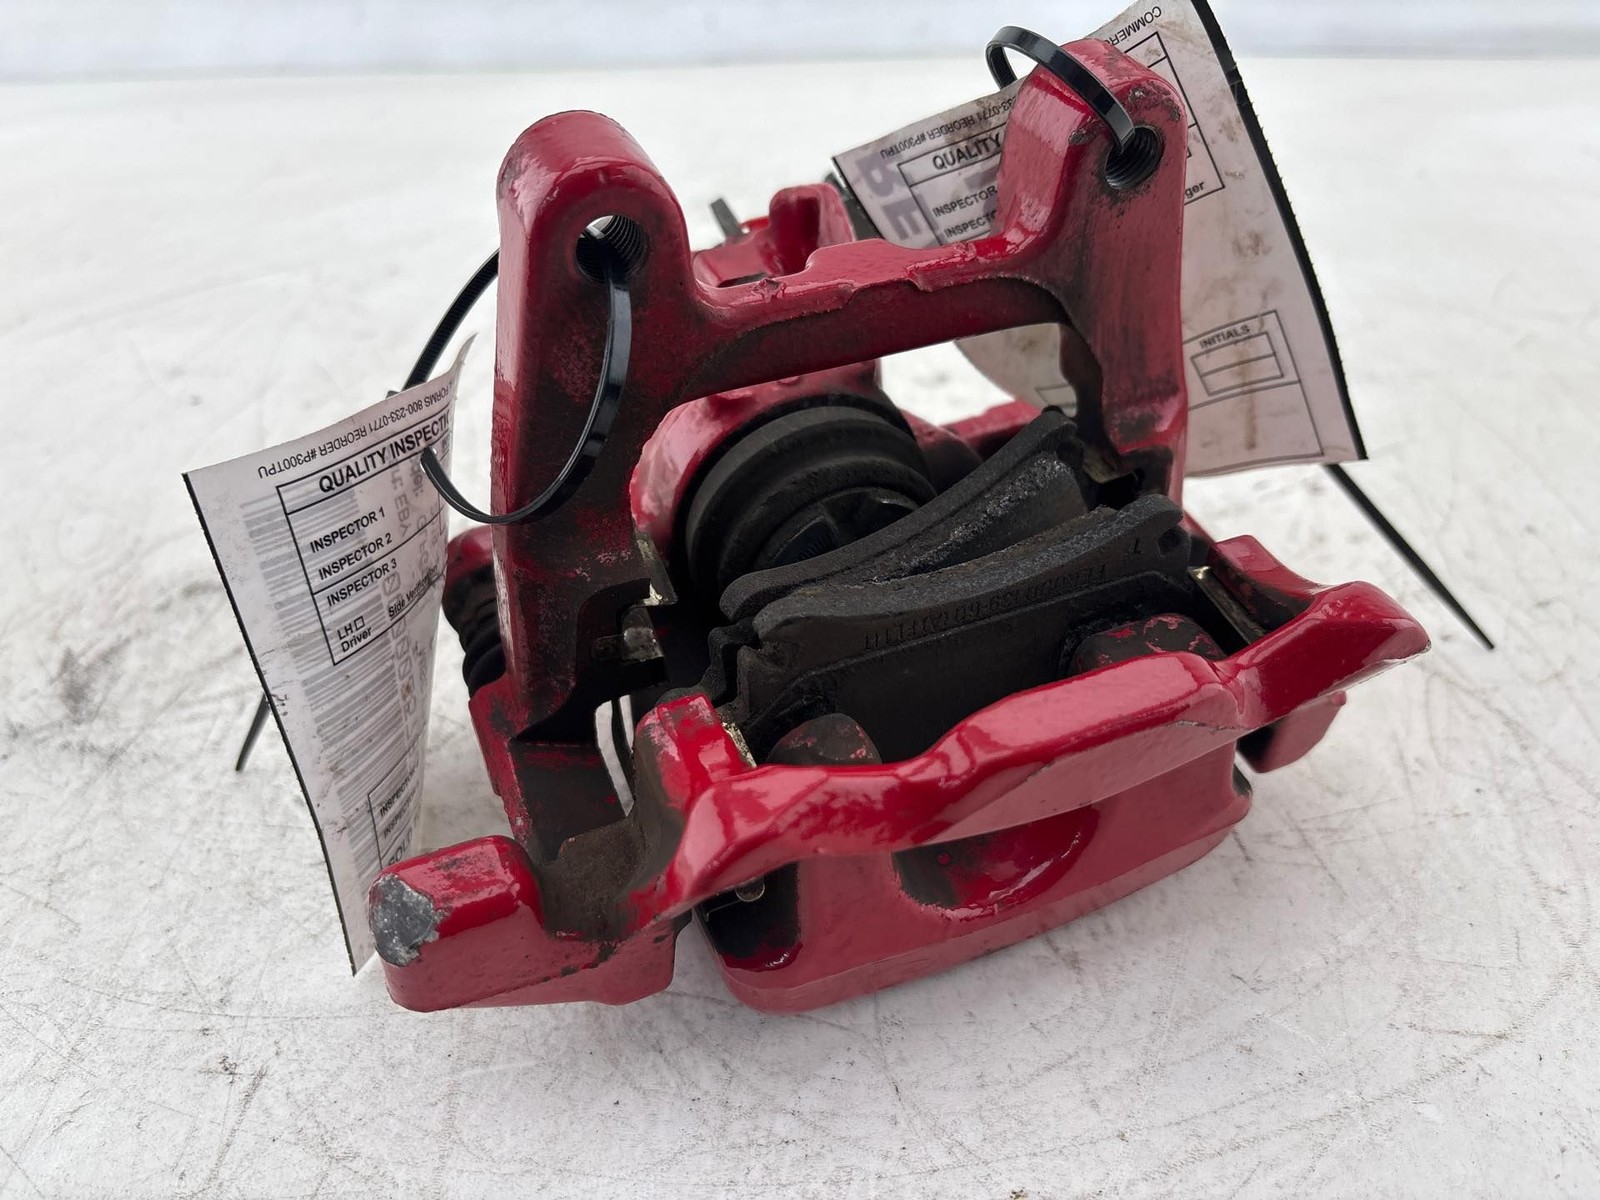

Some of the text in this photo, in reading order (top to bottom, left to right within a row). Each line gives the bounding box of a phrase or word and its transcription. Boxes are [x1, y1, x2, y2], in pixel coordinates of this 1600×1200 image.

[1106, 6, 1162, 46] COMMER
[880, 134, 927, 160] #P300TPU
[927, 115, 975, 141] REORDER
[932, 132, 1001, 170] QUALITY
[932, 185, 997, 217] INSPECTOR
[1200, 324, 1251, 349] INITIALS
[258, 386, 449, 479] FORMS 800-233-0771 REORDER #P300TPU
[319, 446, 387, 494] QUALITY
[310, 506, 386, 554] INSPECTOR 1
[319, 532, 393, 580] INSPECTOR 2
[327, 558, 397, 607] INSPECTOR 3
[388, 565, 438, 618] Side Verification
[337, 622, 354, 640] LH
[341, 626, 372, 652] Driver
